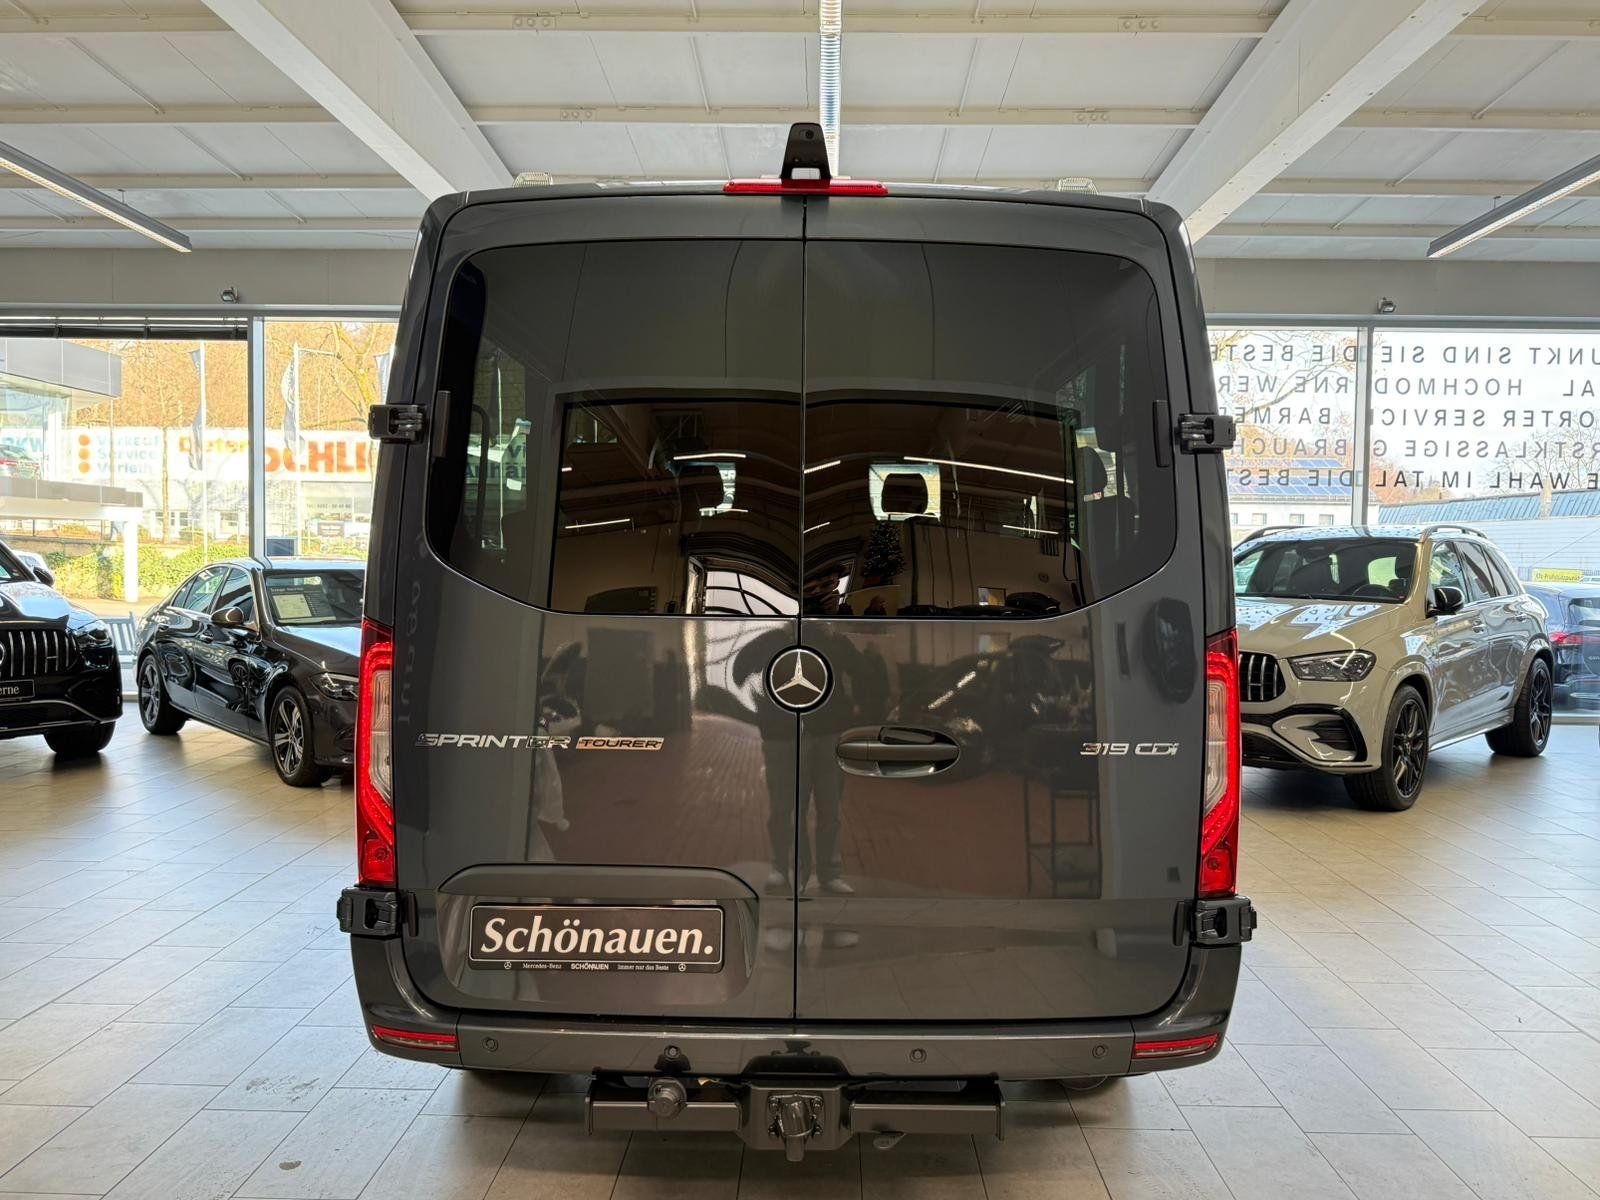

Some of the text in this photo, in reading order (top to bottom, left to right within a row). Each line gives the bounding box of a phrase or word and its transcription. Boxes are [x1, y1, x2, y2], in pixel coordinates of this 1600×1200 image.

[414, 732, 662, 750] SPRINTER TOURER
[1080, 742, 1130, 755] 319
[480, 914, 714, 955] Schönauen.
[522, 962, 562, 970] Mercedes-Benz
